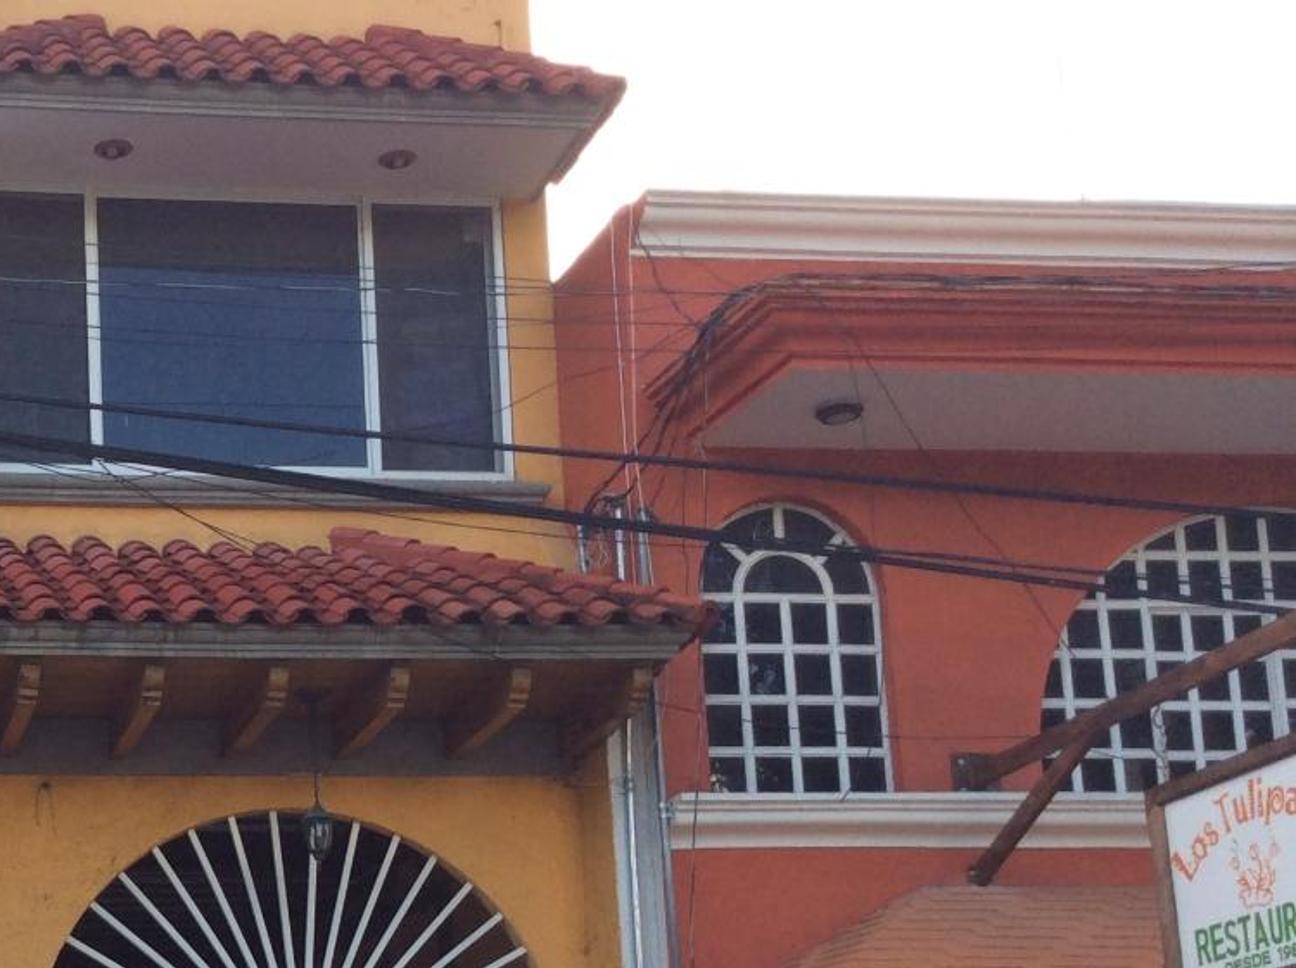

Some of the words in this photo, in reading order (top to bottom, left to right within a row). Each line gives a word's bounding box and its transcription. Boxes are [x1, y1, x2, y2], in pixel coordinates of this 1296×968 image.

[1171, 822, 1219, 882] Los
[1214, 777, 1296, 834] Tulipa
[1194, 901, 1296, 967] RESTAUR
